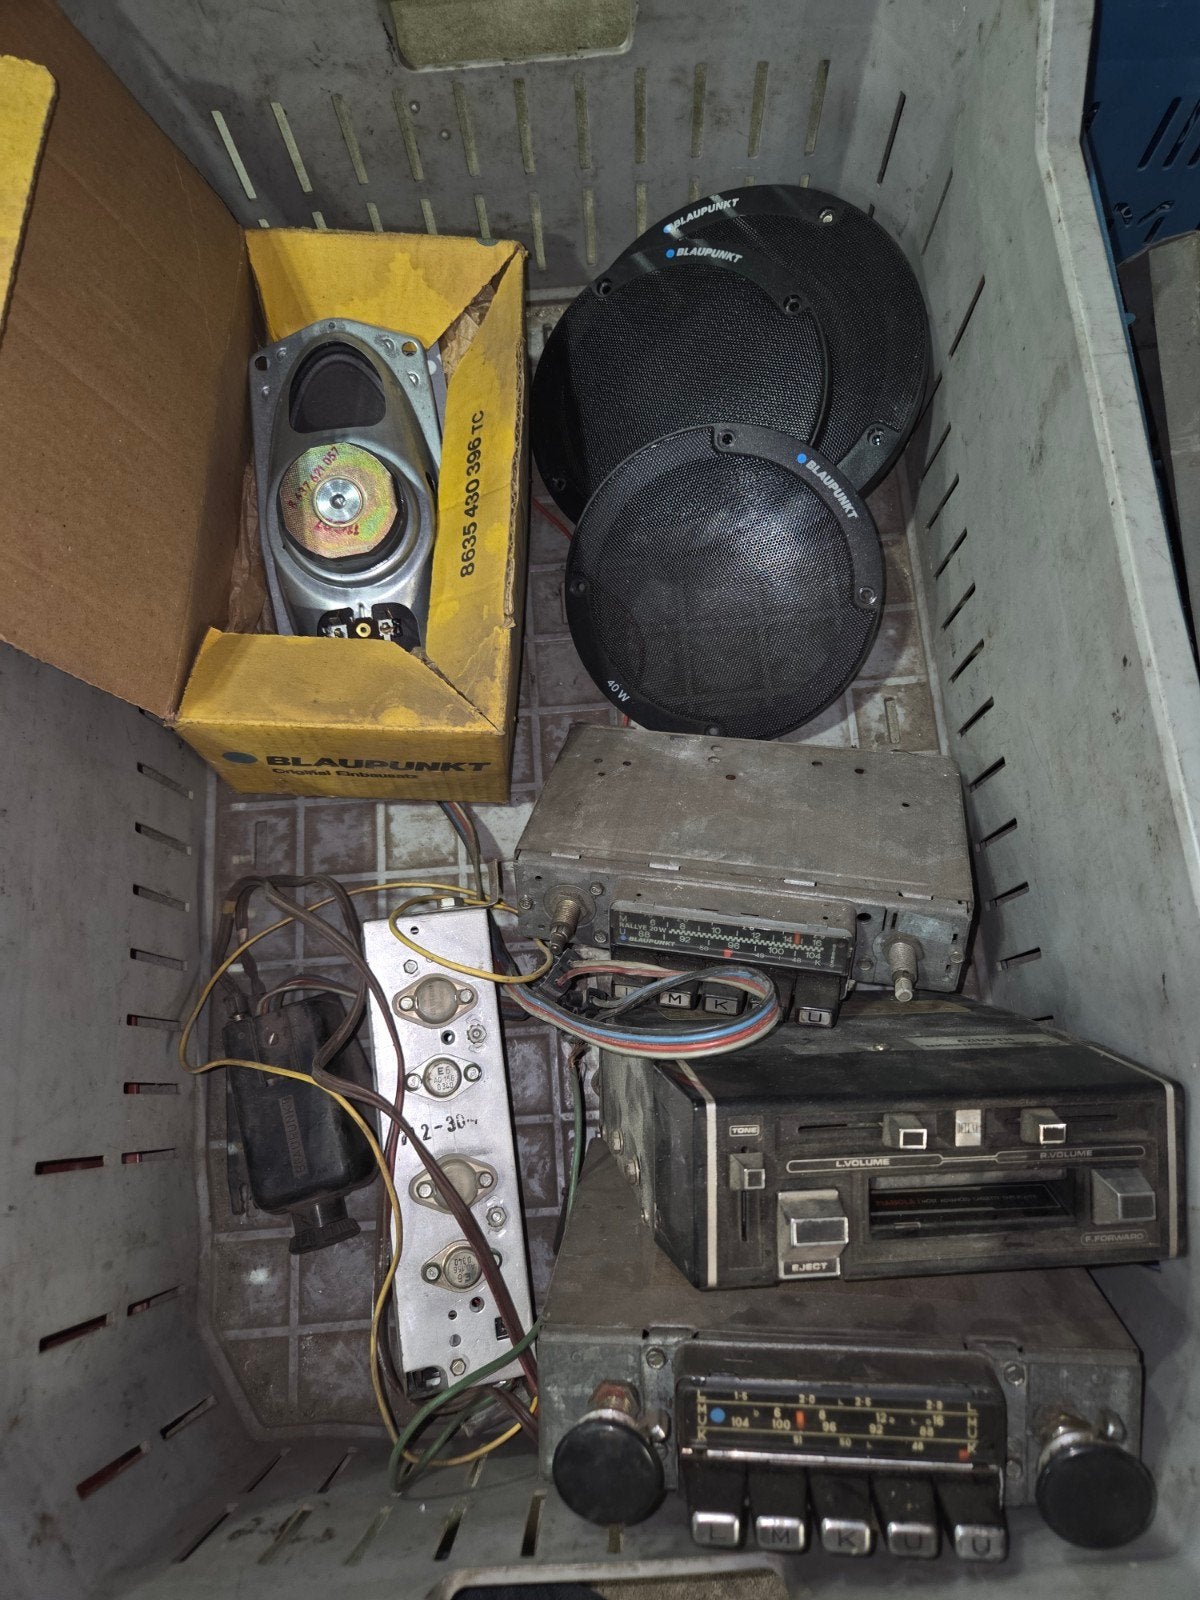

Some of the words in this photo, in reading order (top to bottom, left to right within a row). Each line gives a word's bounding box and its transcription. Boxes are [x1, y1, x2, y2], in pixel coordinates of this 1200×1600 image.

[673, 198, 739, 230] BLAUPUNKT
[676, 248, 743, 264] BLAUPUNKT
[472, 410, 485, 435] TC
[467, 437, 483, 476] 396
[805, 459, 859, 519] BLAUPUNKT
[465, 478, 481, 518] 430
[460, 521, 478, 578] 8635
[607, 679, 620, 693] 40
[618, 689, 630, 702] W
[266, 755, 491, 772] BLAUPUNKT
[619, 921, 647, 930] RALLYE
[628, 936, 675, 947] BLAUPUNKT
[752, 932, 761, 940] 12
[813, 939, 822, 947] 16
[768, 947, 784, 955] 100
[668, 994, 682, 1004] M
[714, 1000, 728, 1011] K
[808, 1013, 822, 1022] U
[835, 1158, 890, 1167] L.VOLUME
[791, 1262, 828, 1272] EJECT
[731, 1416, 750, 1428] 104
[772, 1418, 791, 1430] 100
[822, 1421, 837, 1432] 96
[869, 1423, 883, 1435] 92
[876, 1412, 887, 1424] 12
[709, 1524, 726, 1540] L
[771, 1528, 790, 1544] M
[838, 1530, 855, 1547] K
